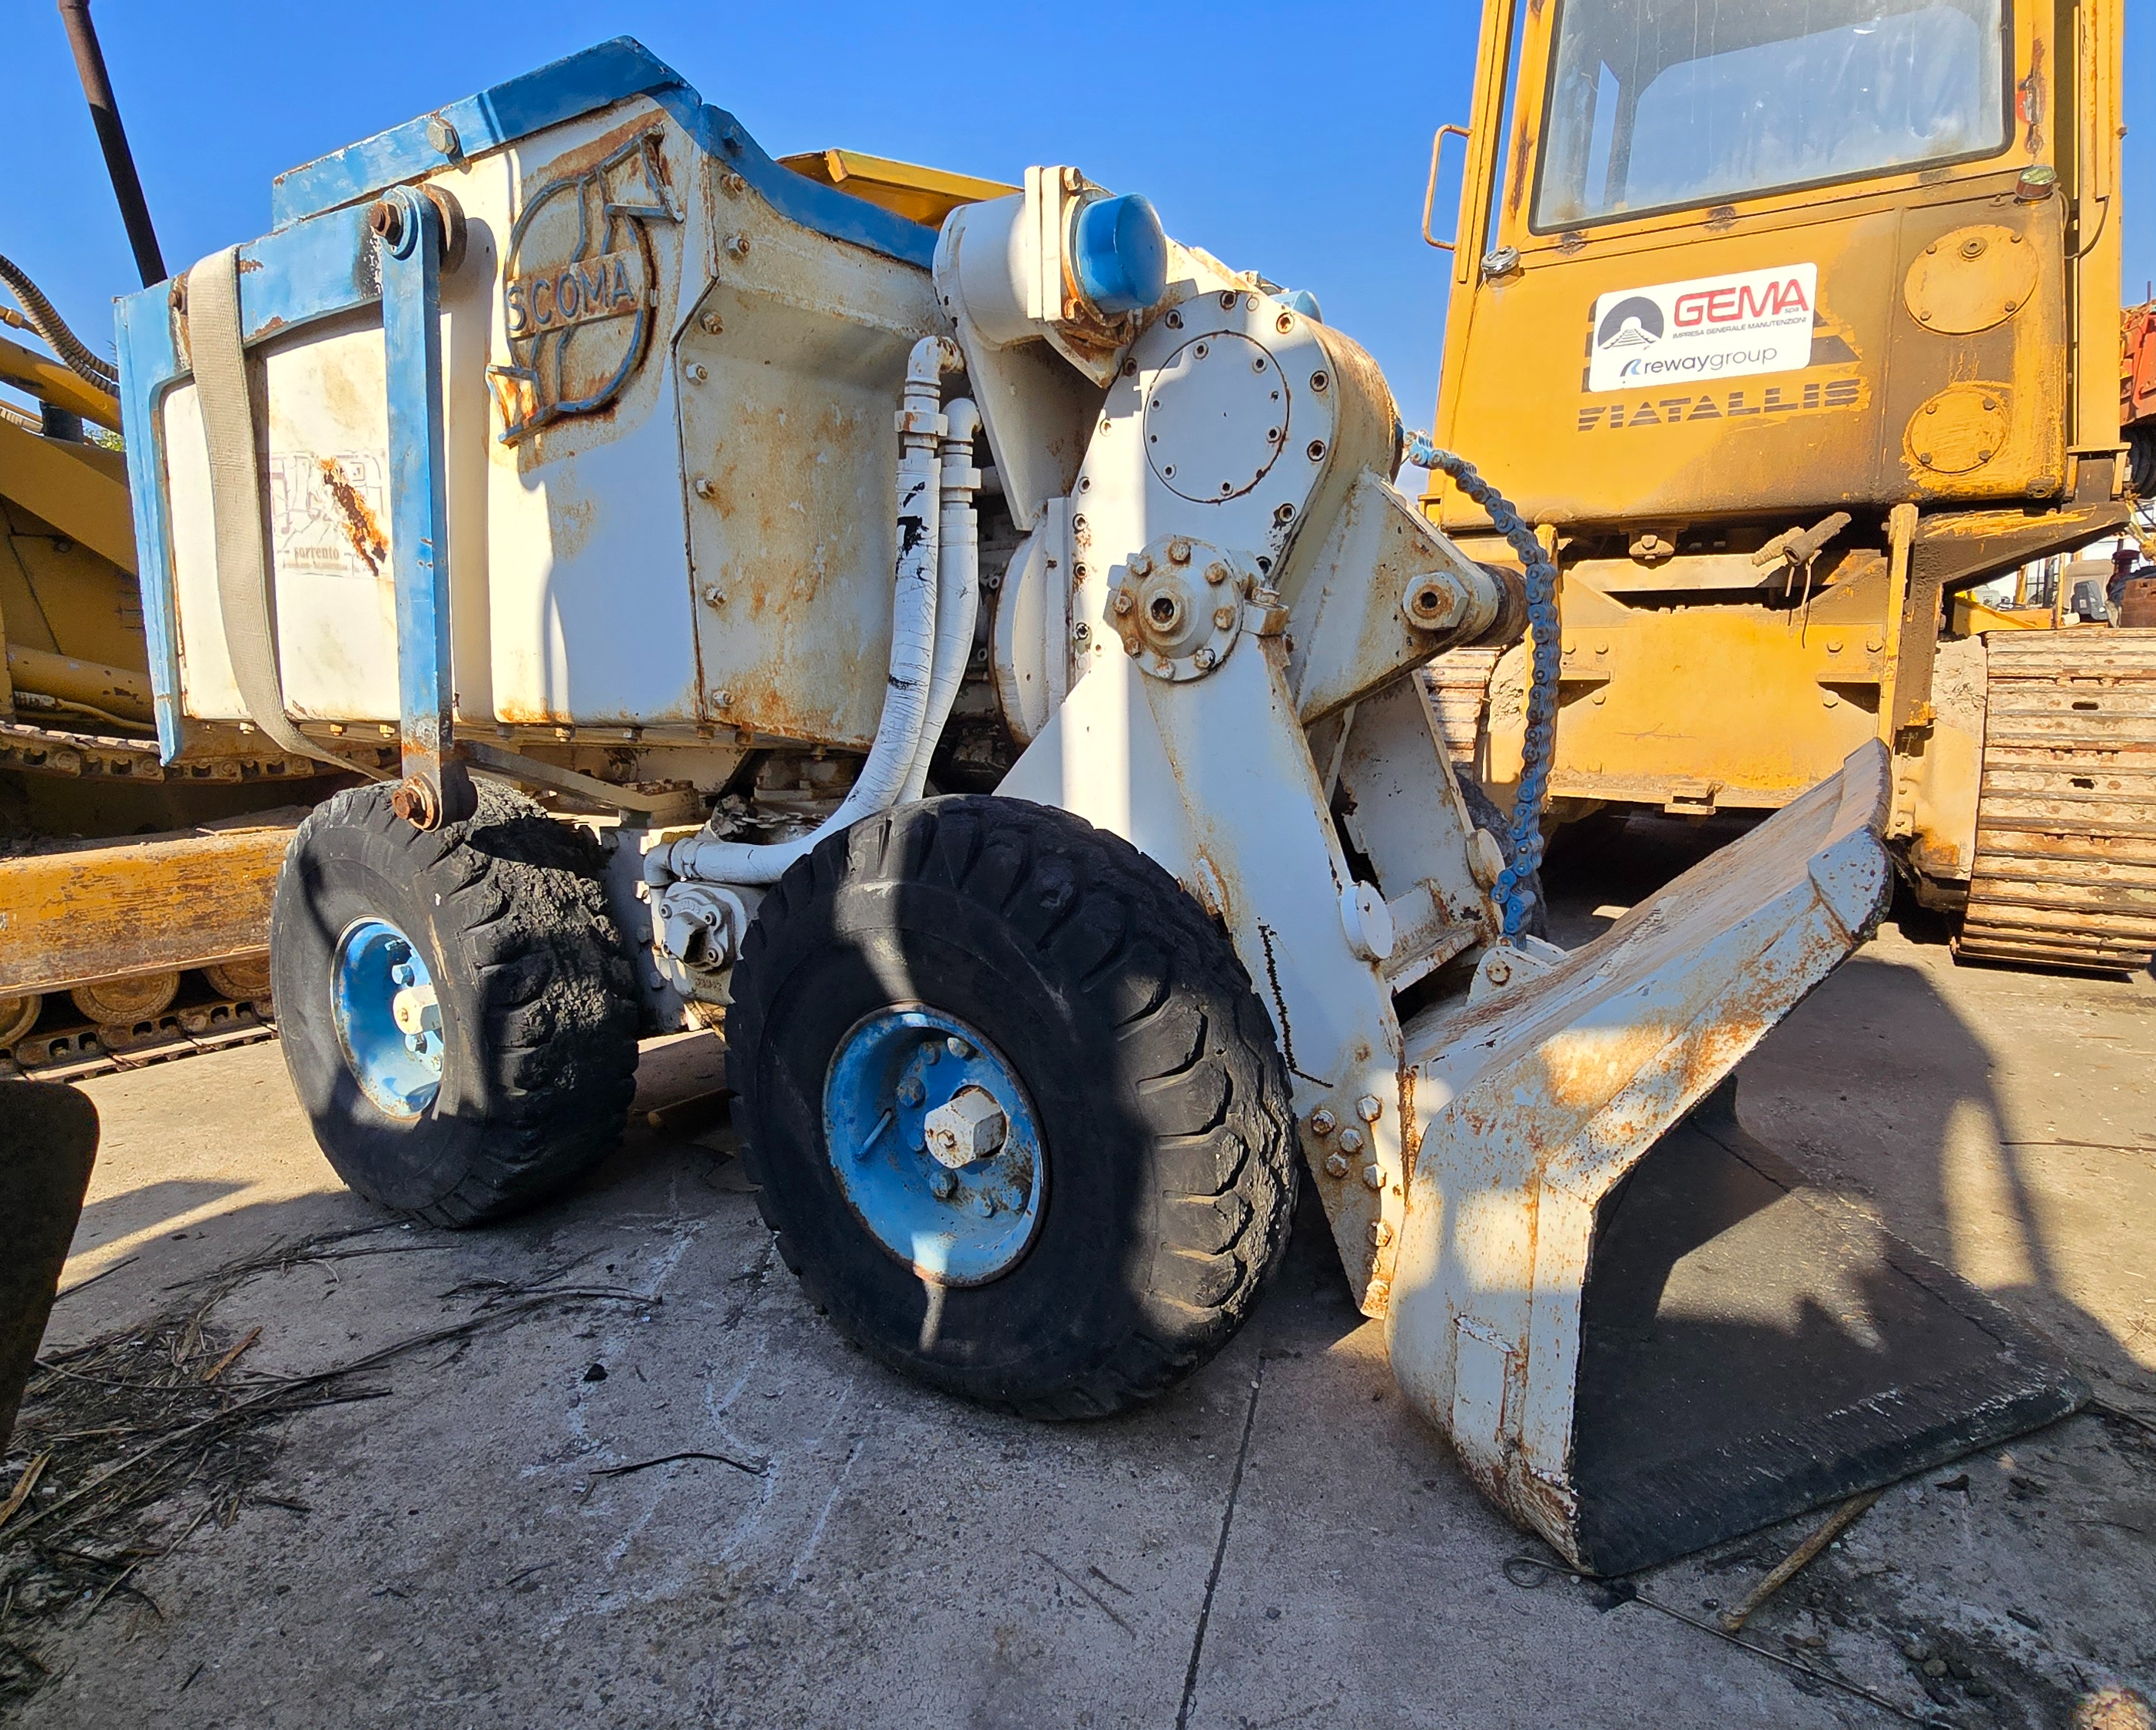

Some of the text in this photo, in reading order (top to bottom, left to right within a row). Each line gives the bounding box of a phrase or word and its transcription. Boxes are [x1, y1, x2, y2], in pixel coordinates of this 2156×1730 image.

[505, 260, 635, 331] SCOMA
[1674, 279, 1809, 327] GEMA
[1673, 317, 1807, 340] IMPRESA GENERALE MANUTENZIONI
[1644, 346, 1777, 374] rewaygroup
[1577, 379, 1862, 432] FIATALLIS
